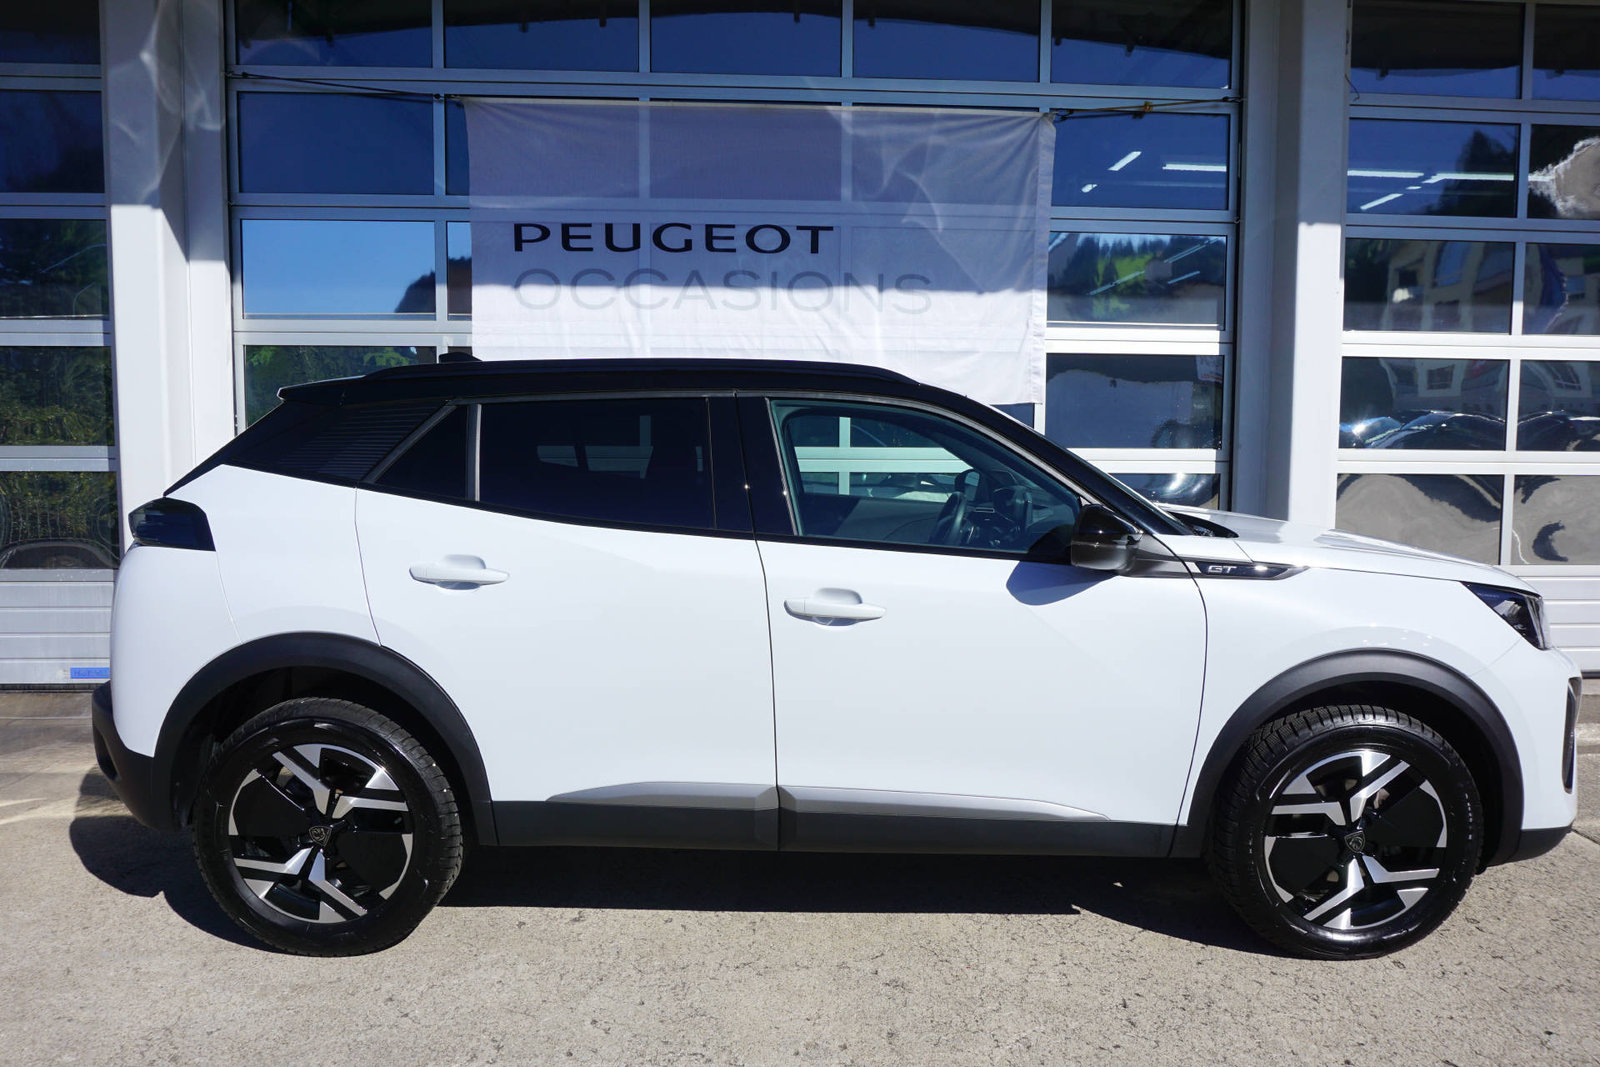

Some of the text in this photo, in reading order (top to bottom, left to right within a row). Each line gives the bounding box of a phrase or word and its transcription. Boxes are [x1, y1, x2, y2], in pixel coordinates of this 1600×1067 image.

[513, 222, 834, 254] PEUGEOT
[514, 267, 932, 315] OCCASIONS
[1208, 565, 1237, 573] GT
